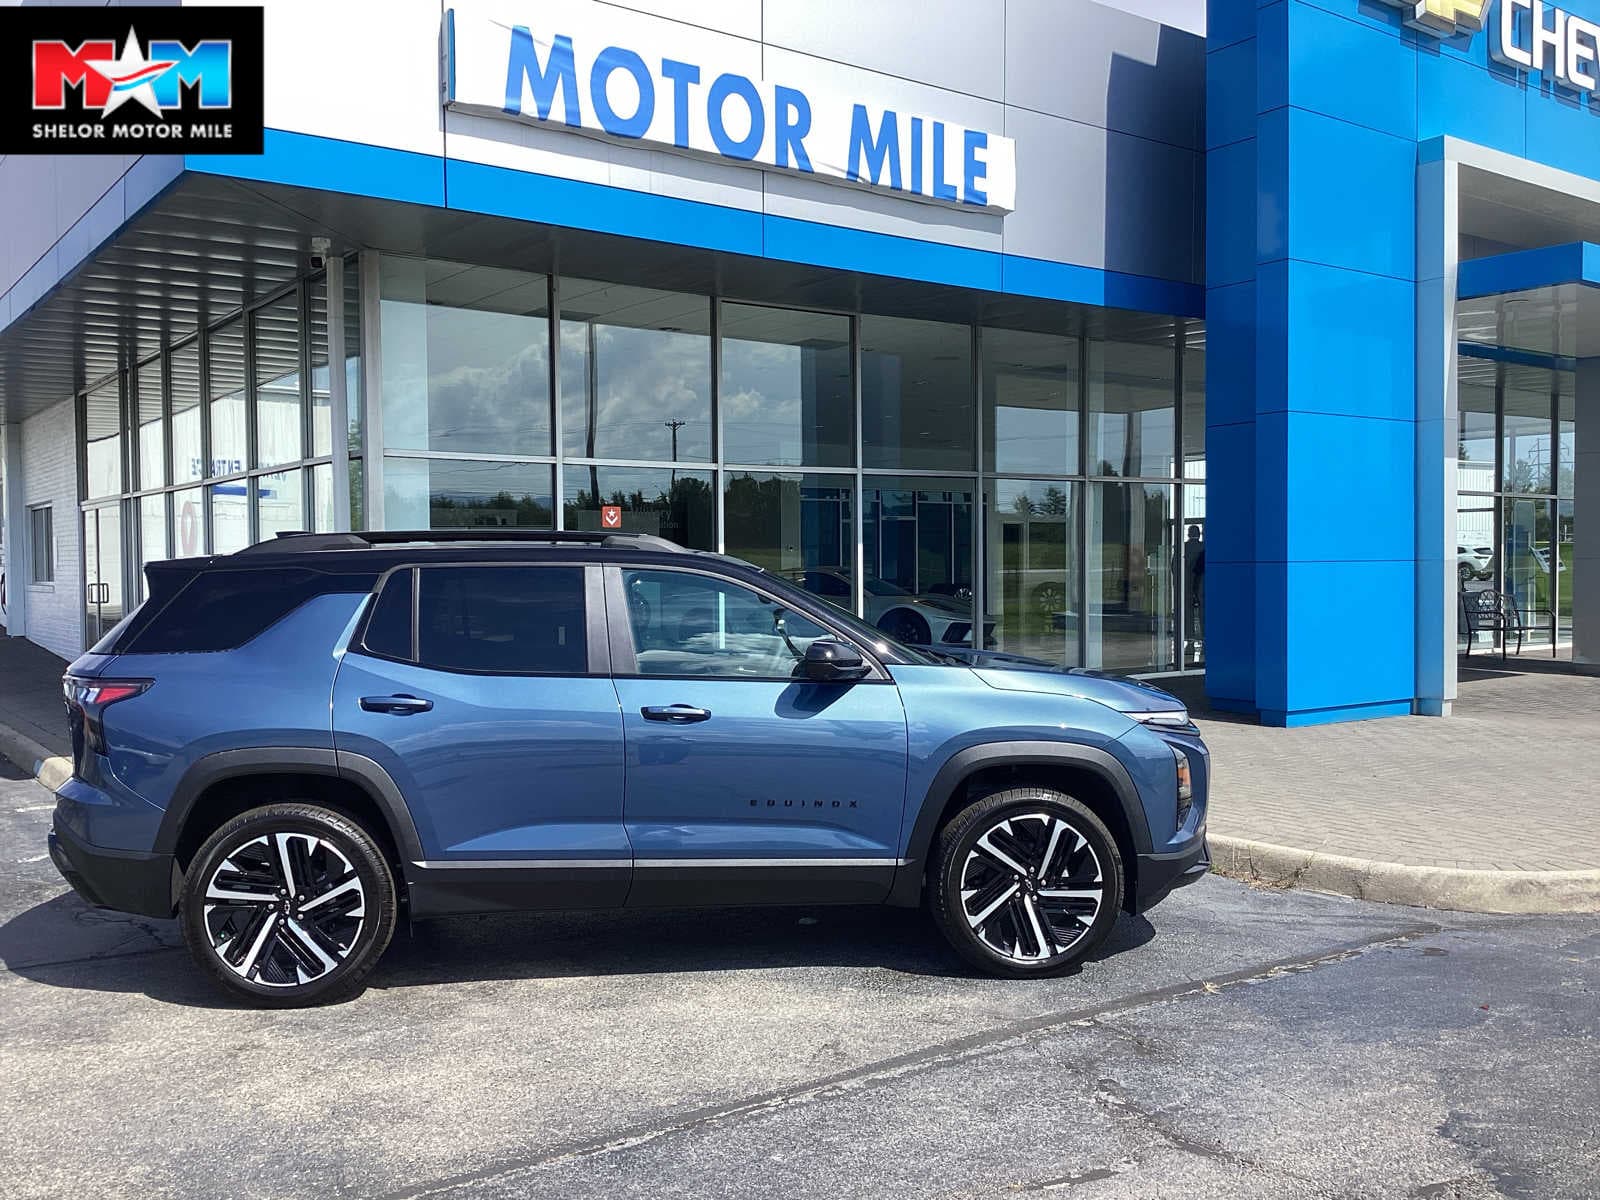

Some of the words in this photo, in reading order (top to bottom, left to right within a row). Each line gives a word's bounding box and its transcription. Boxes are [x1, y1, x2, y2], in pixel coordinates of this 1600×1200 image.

[1499, 0, 1600, 90] CHE
[502, 25, 814, 173] MOTOR
[847, 103, 988, 206] MILE
